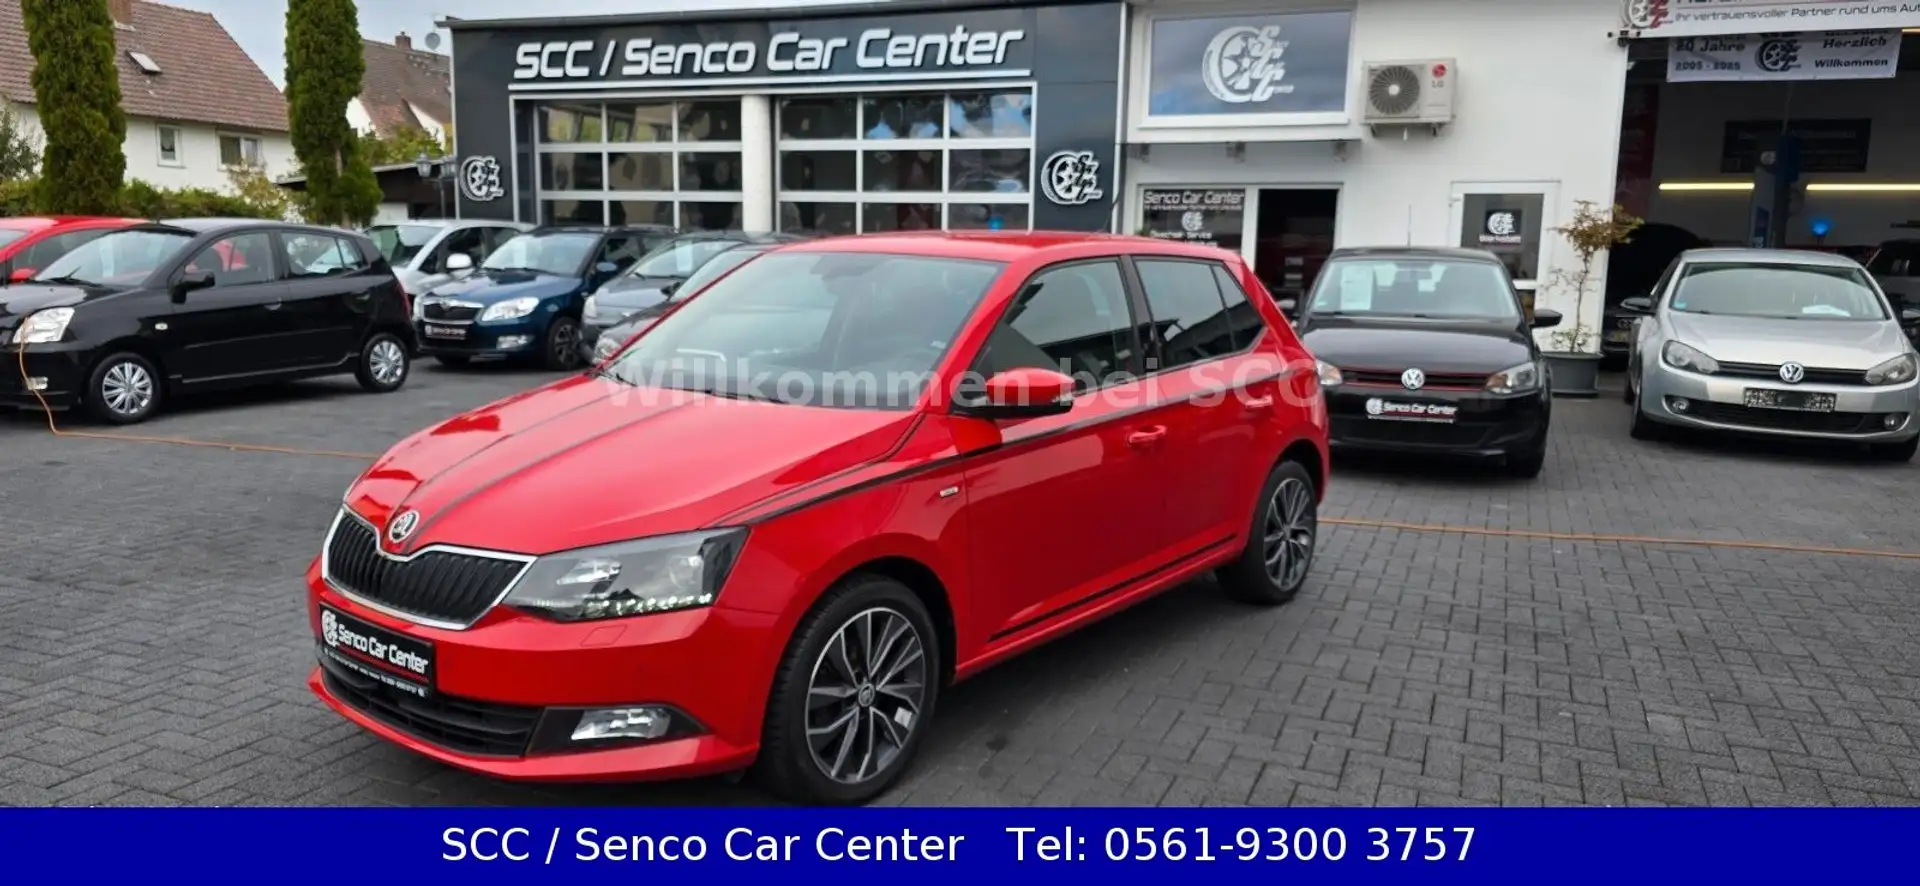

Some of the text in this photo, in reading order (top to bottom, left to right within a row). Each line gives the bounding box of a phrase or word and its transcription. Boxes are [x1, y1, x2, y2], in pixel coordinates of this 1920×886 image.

[1791, 7, 1836, 17] Partner
[1839, 4, 1869, 15] rund
[1871, 5, 1897, 14] ums
[1700, 41, 1746, 53] Jahre
[1823, 37, 1887, 49] Herzlich
[513, 24, 1024, 79] SCC / Senco Car Center
[1815, 58, 1889, 68] Willkommen
[1431, 80, 1444, 88] LG
[1144, 191, 1244, 204] Senco Car Center
[338, 623, 368, 653] Senco
[368, 636, 388, 660] Car
[388, 644, 429, 675] Center
